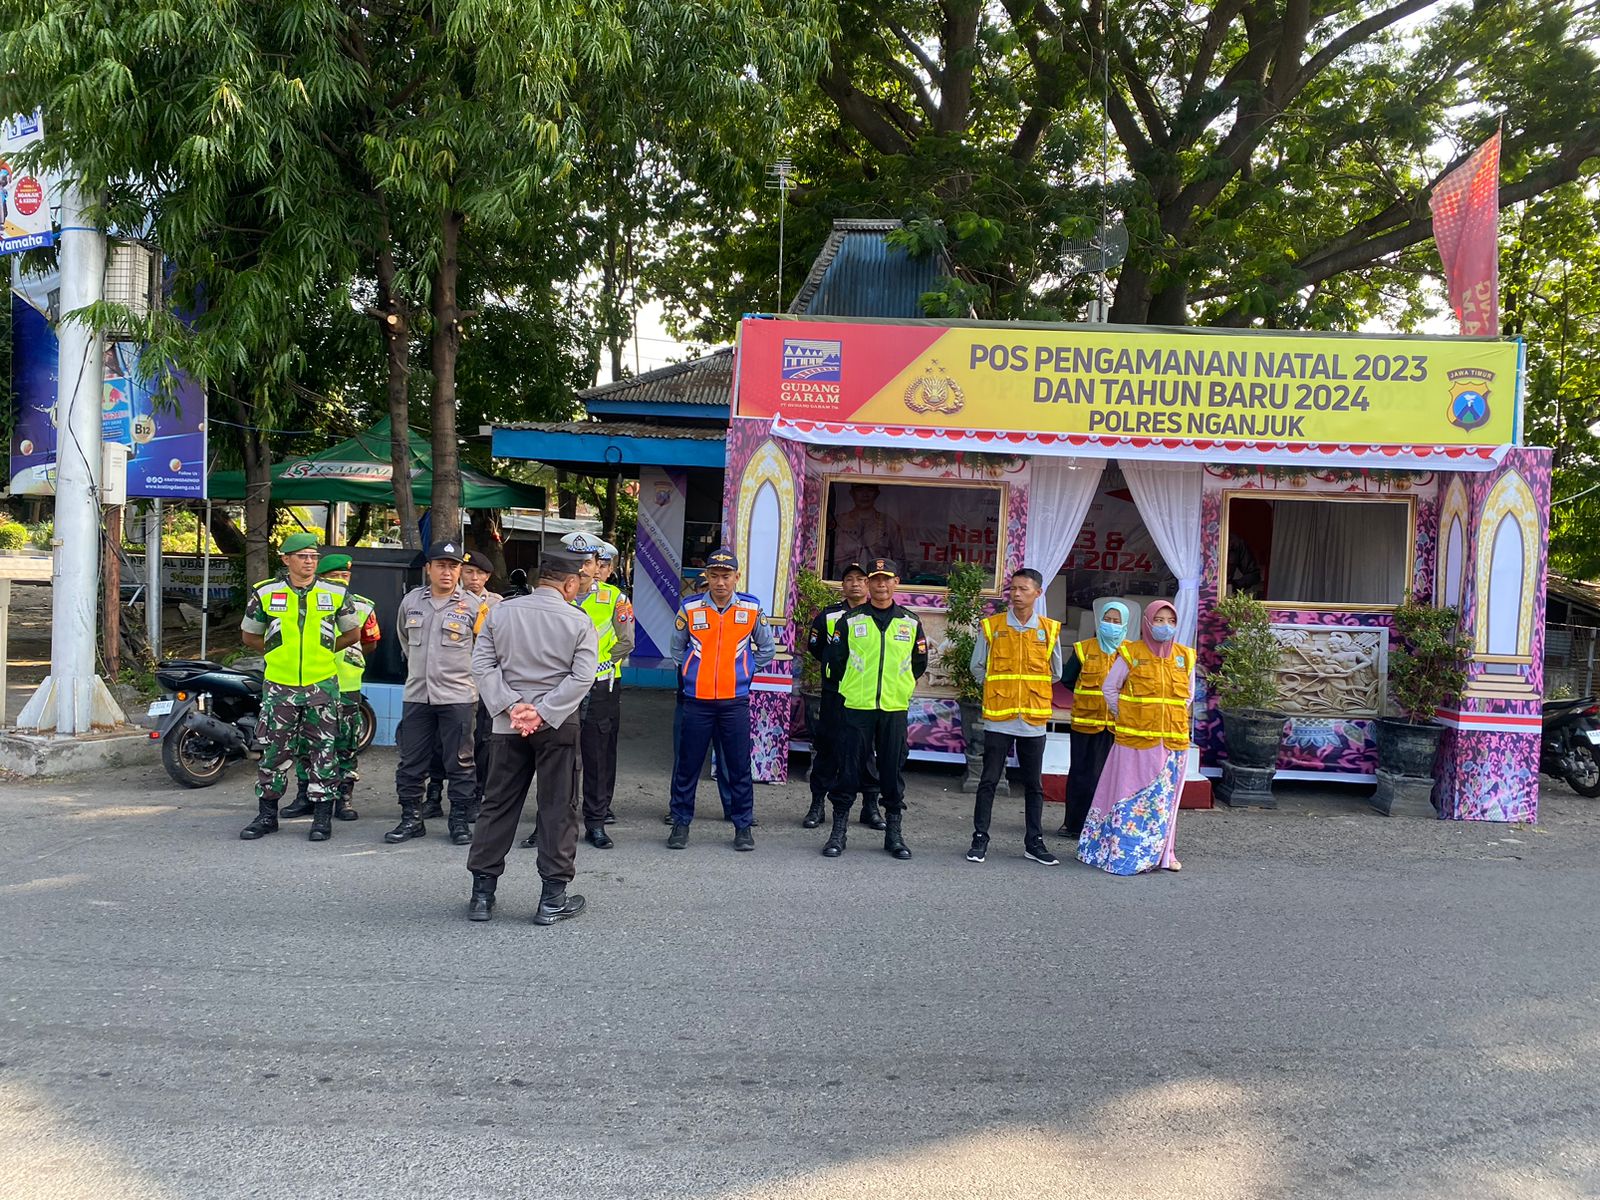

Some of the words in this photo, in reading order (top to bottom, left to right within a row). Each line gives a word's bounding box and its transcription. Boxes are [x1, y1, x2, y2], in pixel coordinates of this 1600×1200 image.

[0, 235, 43, 252] Yamaha
[970, 344, 1028, 371] POS
[1035, 346, 1247, 377] PENGAMANAN
[1254, 352, 1347, 380] NATAL
[1353, 354, 1428, 382] 2023
[1450, 370, 1469, 379] JAWA
[1471, 369, 1492, 379] TIMUR
[781, 382, 840, 394] GUDANG
[1033, 377, 1096, 405] DAN
[1100, 379, 1201, 407] TAHUN
[1208, 382, 1289, 409] BARU
[1294, 384, 1370, 411] 2024
[780, 392, 840, 404] GARAM
[135, 423, 151, 434] B12
[1089, 410, 1182, 434] POLRES
[1187, 412, 1305, 437] NGANJUK
[948, 523, 994, 545] Nat
[1083, 551, 1152, 573] 2024
[447, 612, 468, 621] POLRI
